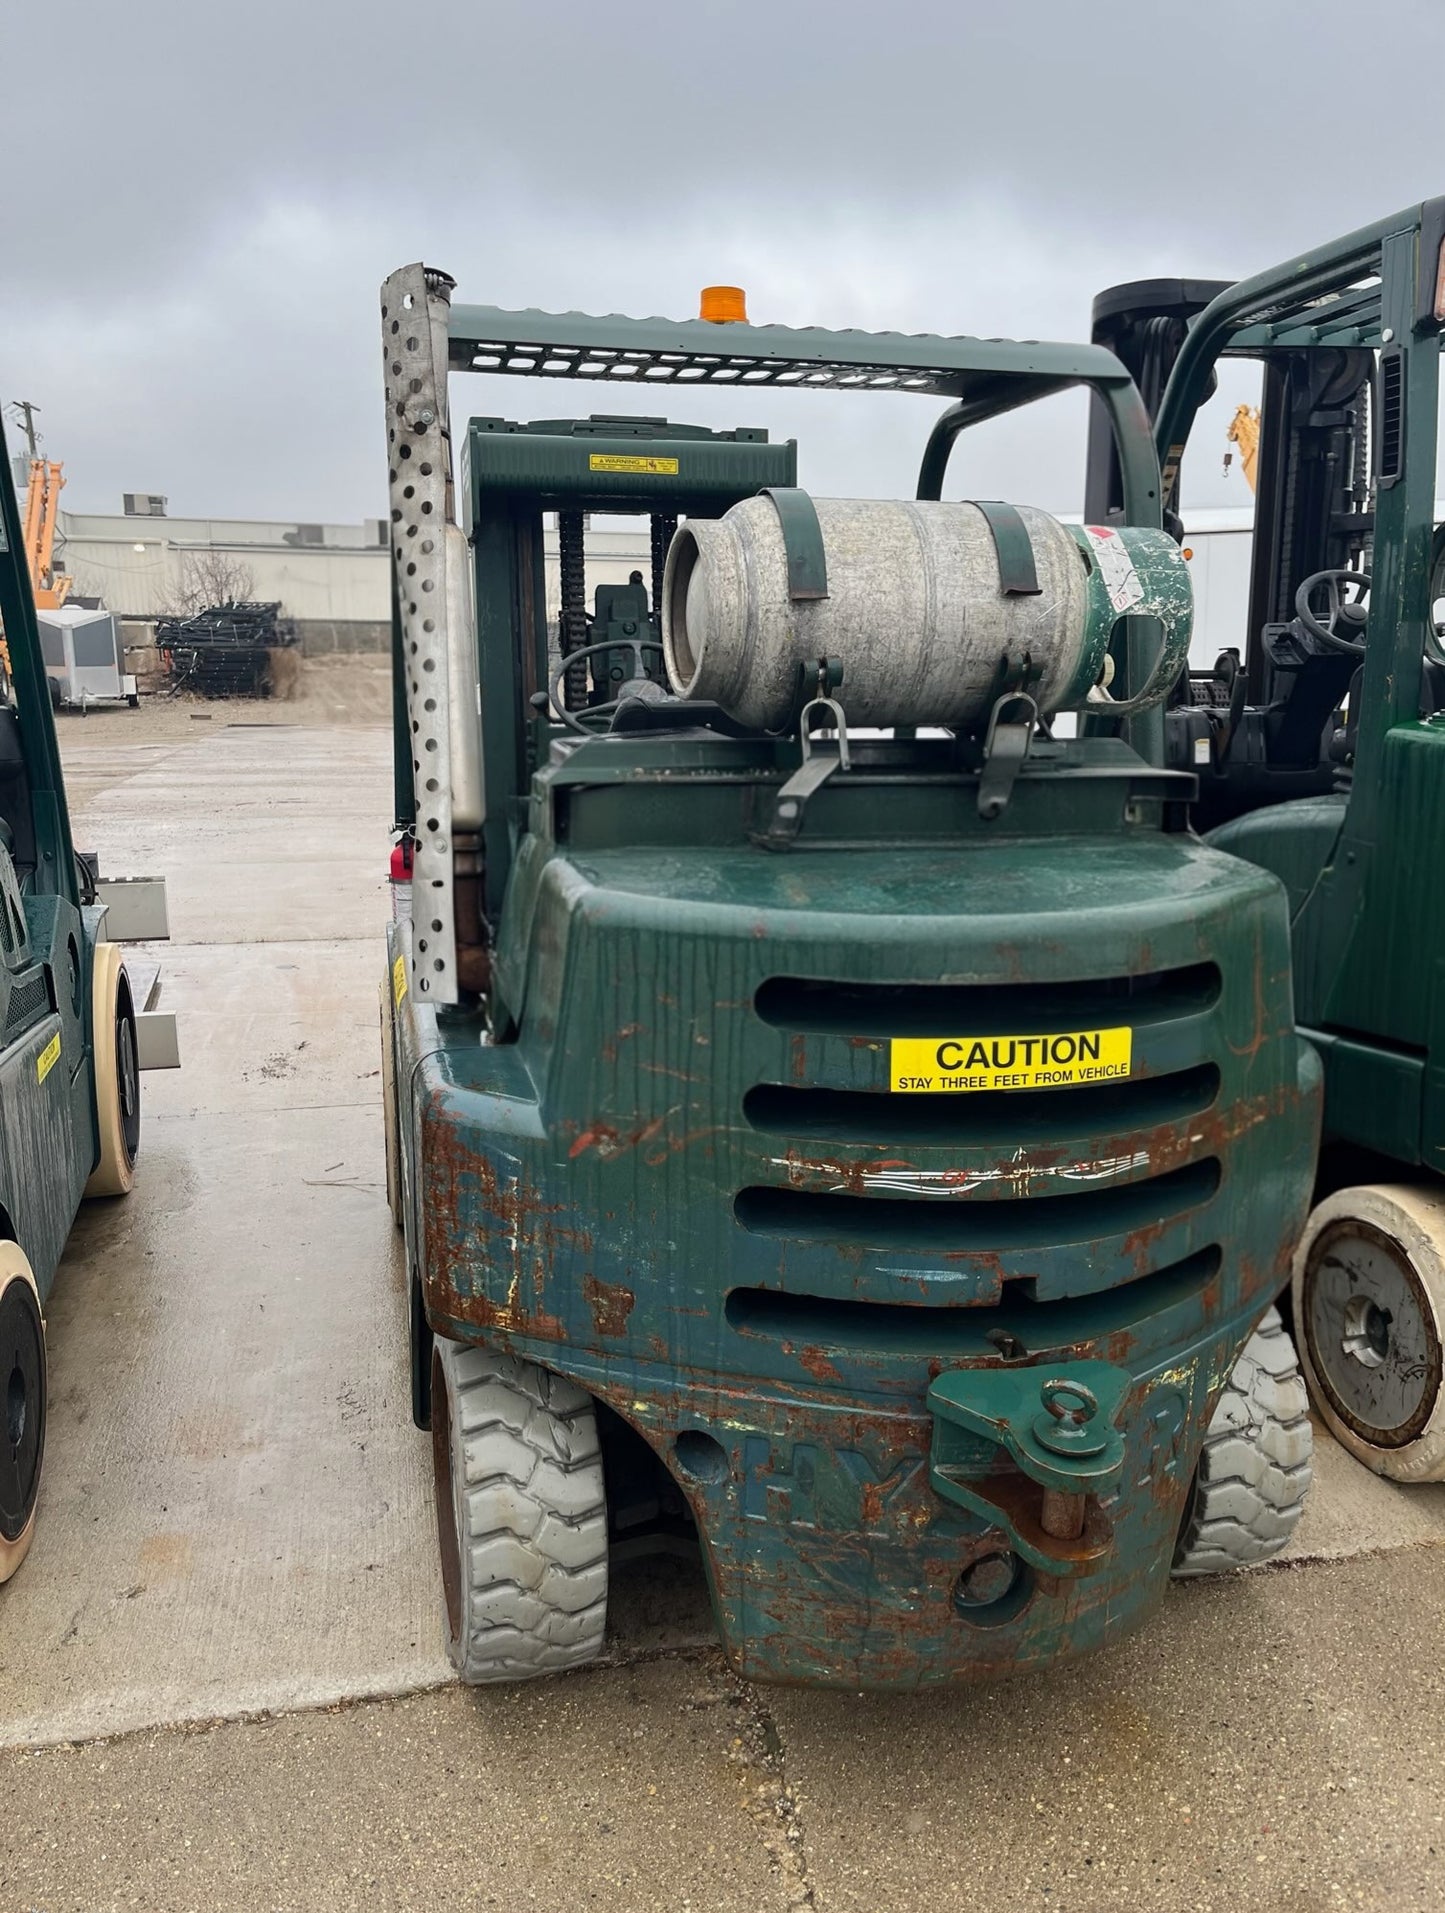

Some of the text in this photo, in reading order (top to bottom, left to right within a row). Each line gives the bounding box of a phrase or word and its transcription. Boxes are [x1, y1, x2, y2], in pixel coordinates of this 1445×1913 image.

[936, 1033, 1100, 1070] CAUTION
[898, 1062, 1128, 1089] STAY THREE FEET FROM VEHICLE
